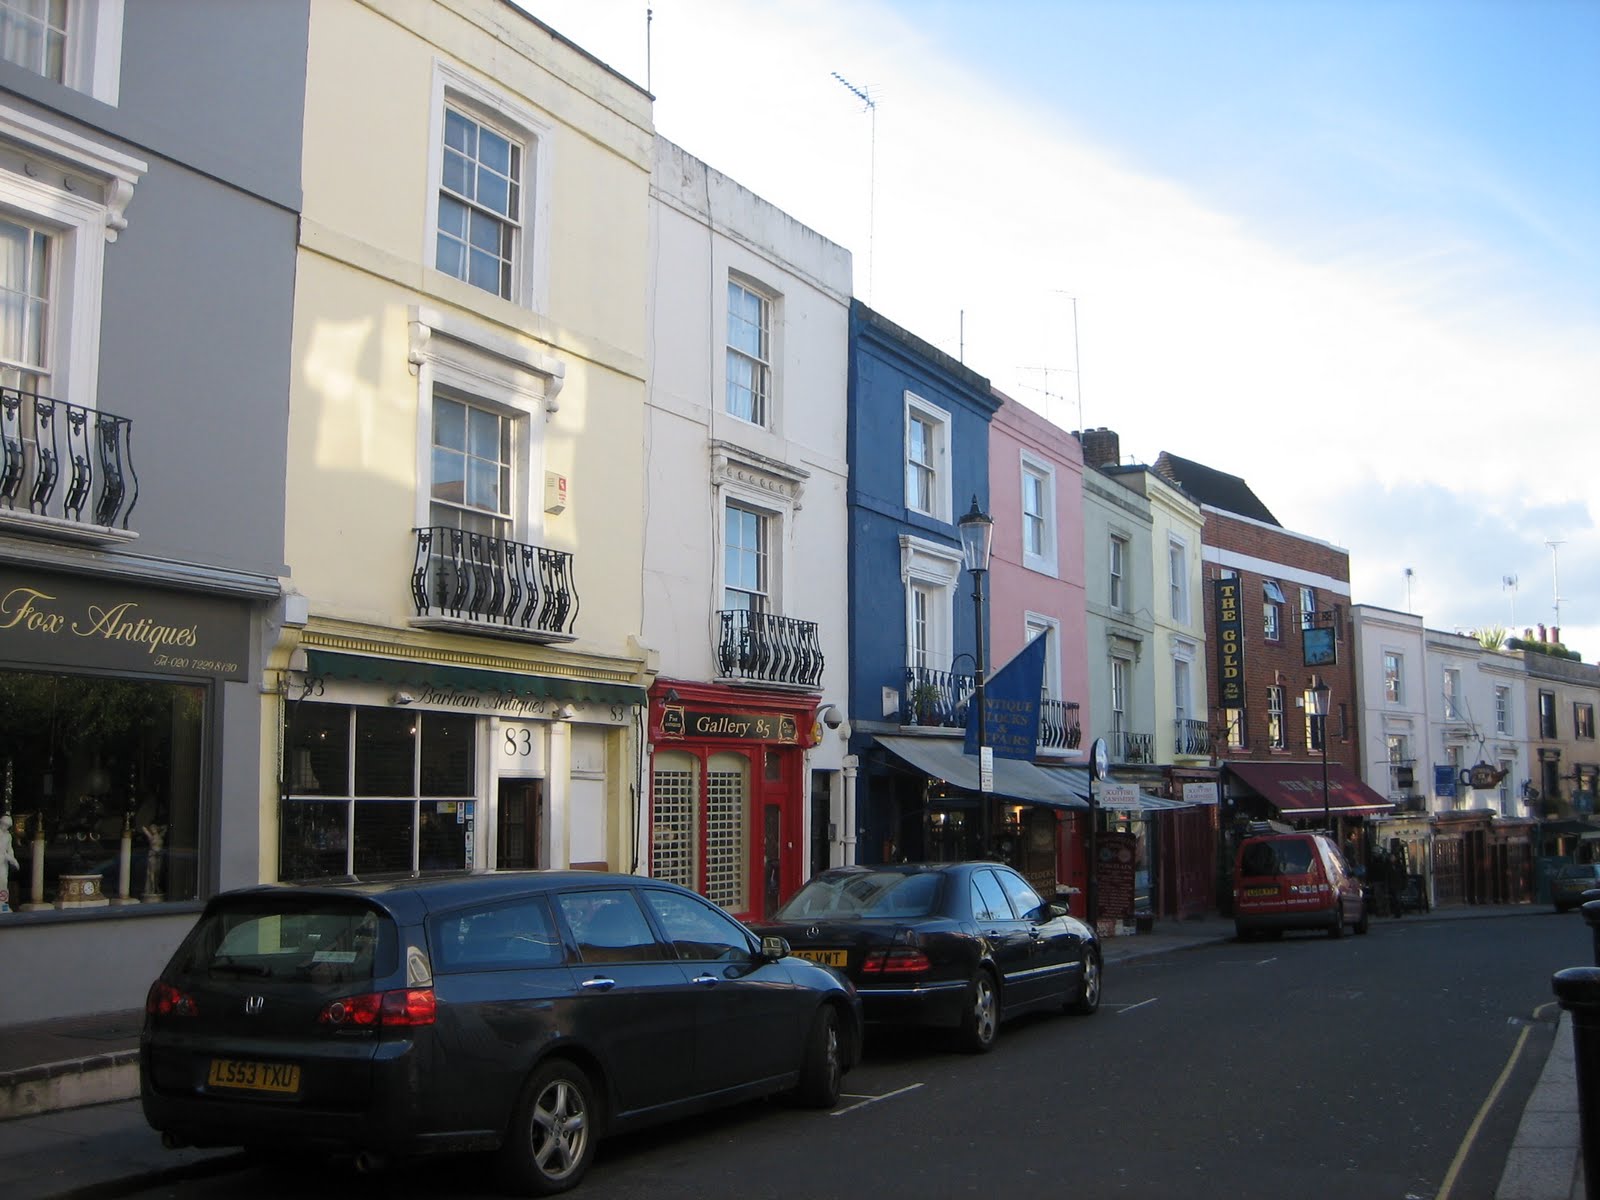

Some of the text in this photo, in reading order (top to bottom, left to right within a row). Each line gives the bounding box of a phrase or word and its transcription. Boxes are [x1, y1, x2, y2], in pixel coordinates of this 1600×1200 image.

[1220, 585, 1236, 622] THE
[0, 587, 200, 654] Fox Antiques
[1222, 629, 1238, 679] GOLD
[302, 676, 325, 697] 83
[413, 686, 546, 717] Barham Antiques
[609, 704, 625, 722] 83
[984, 699, 1034, 713] NTIQUE
[696, 716, 751, 738] Gallery
[755, 719, 771, 739] 85
[984, 712, 1031, 727] LOCKS
[503, 727, 532, 757] 83
[815, 952, 841, 965] VWT
[215, 1062, 294, 1088] LS53 TXU
